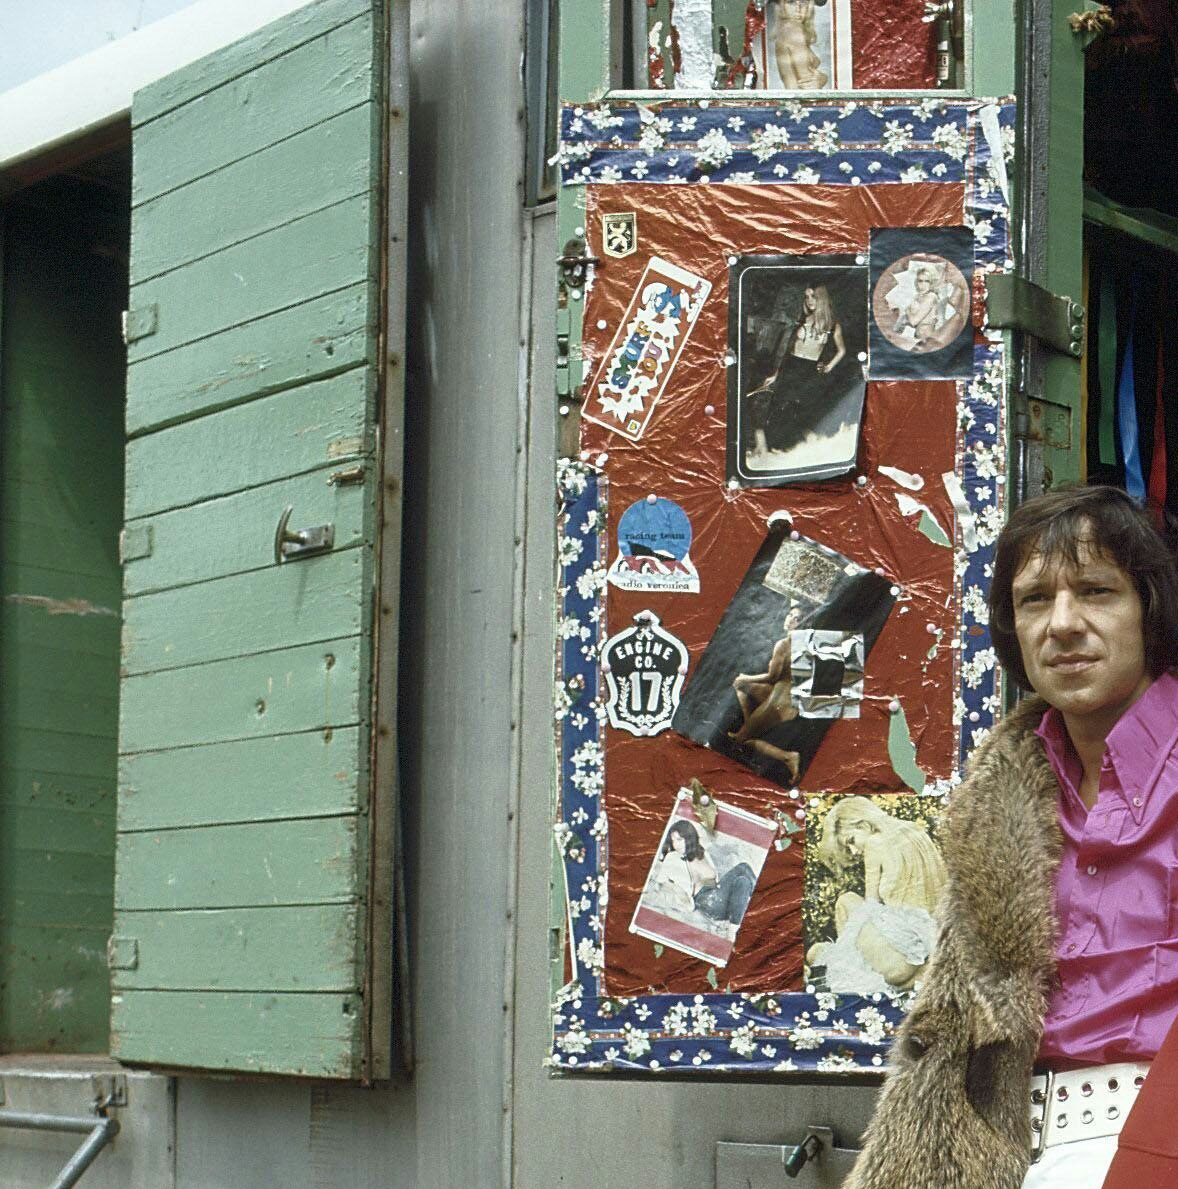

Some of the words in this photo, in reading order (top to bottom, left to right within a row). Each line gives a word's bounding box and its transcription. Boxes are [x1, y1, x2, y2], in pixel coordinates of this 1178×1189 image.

[611, 320, 651, 390] SMURF
[624, 532, 657, 542] racing
[660, 532, 685, 540] team
[619, 578, 643, 589] adio
[647, 580, 690, 591] veronica
[615, 641, 673, 661] ENGINE
[635, 655, 657, 669] CO.
[629, 671, 662, 712] 17
